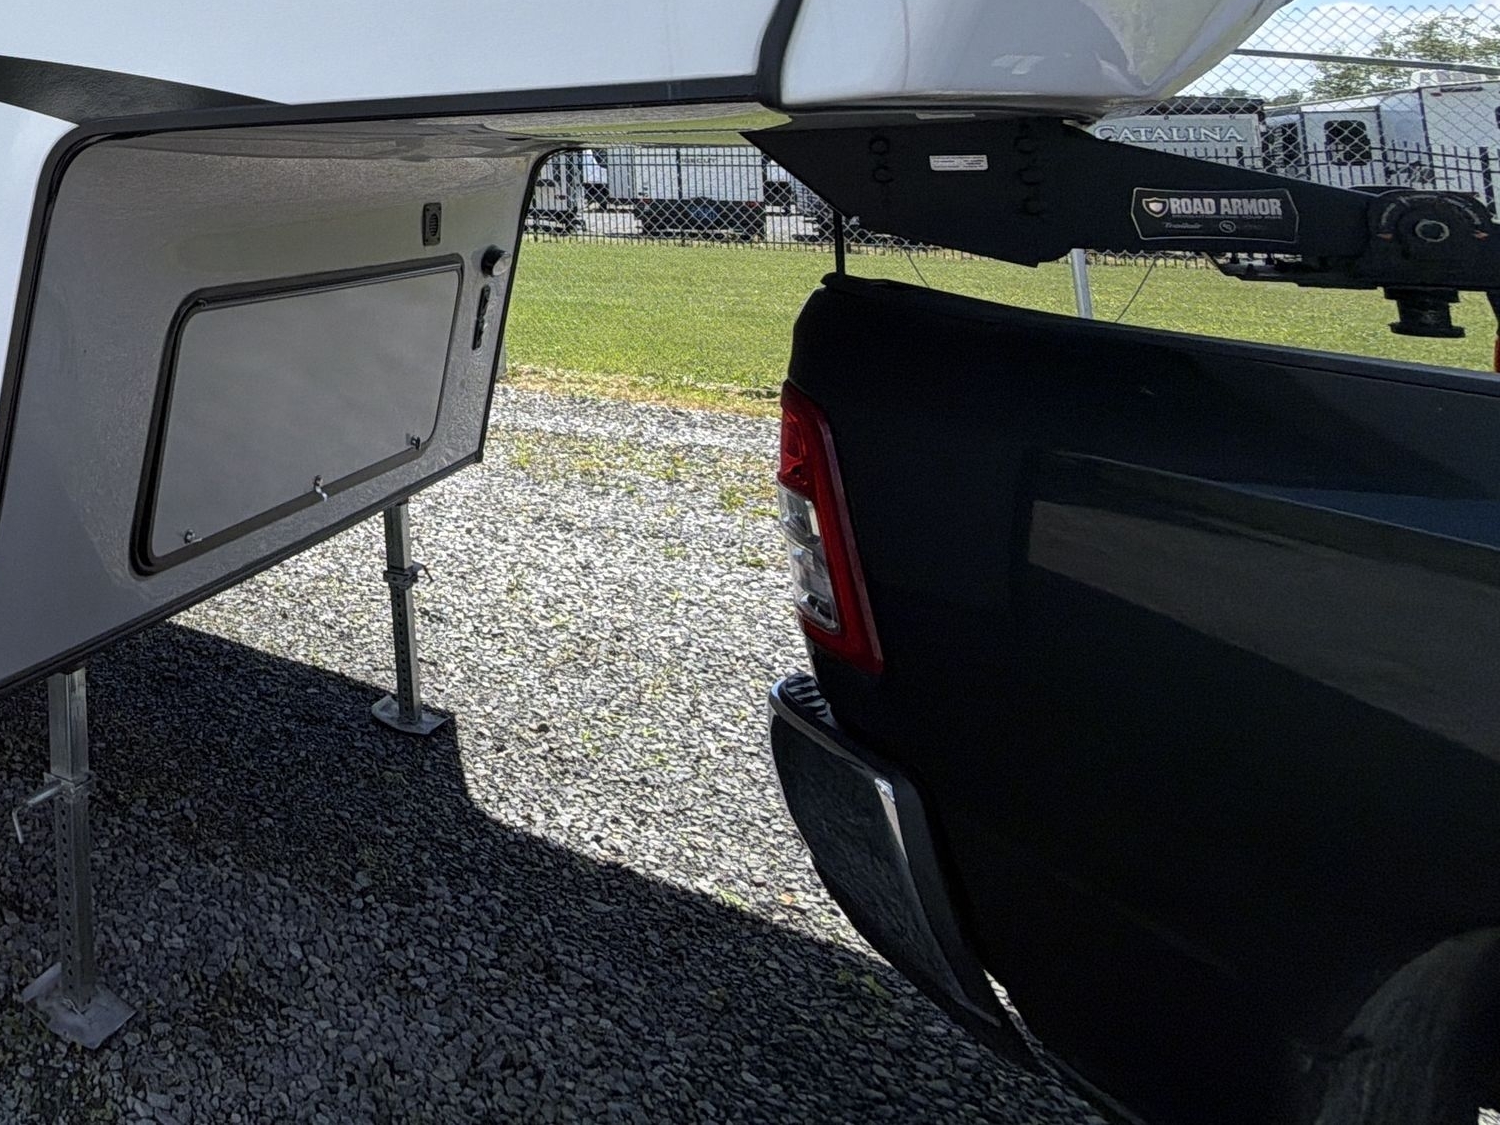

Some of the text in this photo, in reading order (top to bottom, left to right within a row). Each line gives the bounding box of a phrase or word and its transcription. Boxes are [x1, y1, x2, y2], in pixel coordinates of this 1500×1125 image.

[1094, 126, 1247, 142] CATALINA
[1169, 197, 1283, 216] ROAD ARMOR
